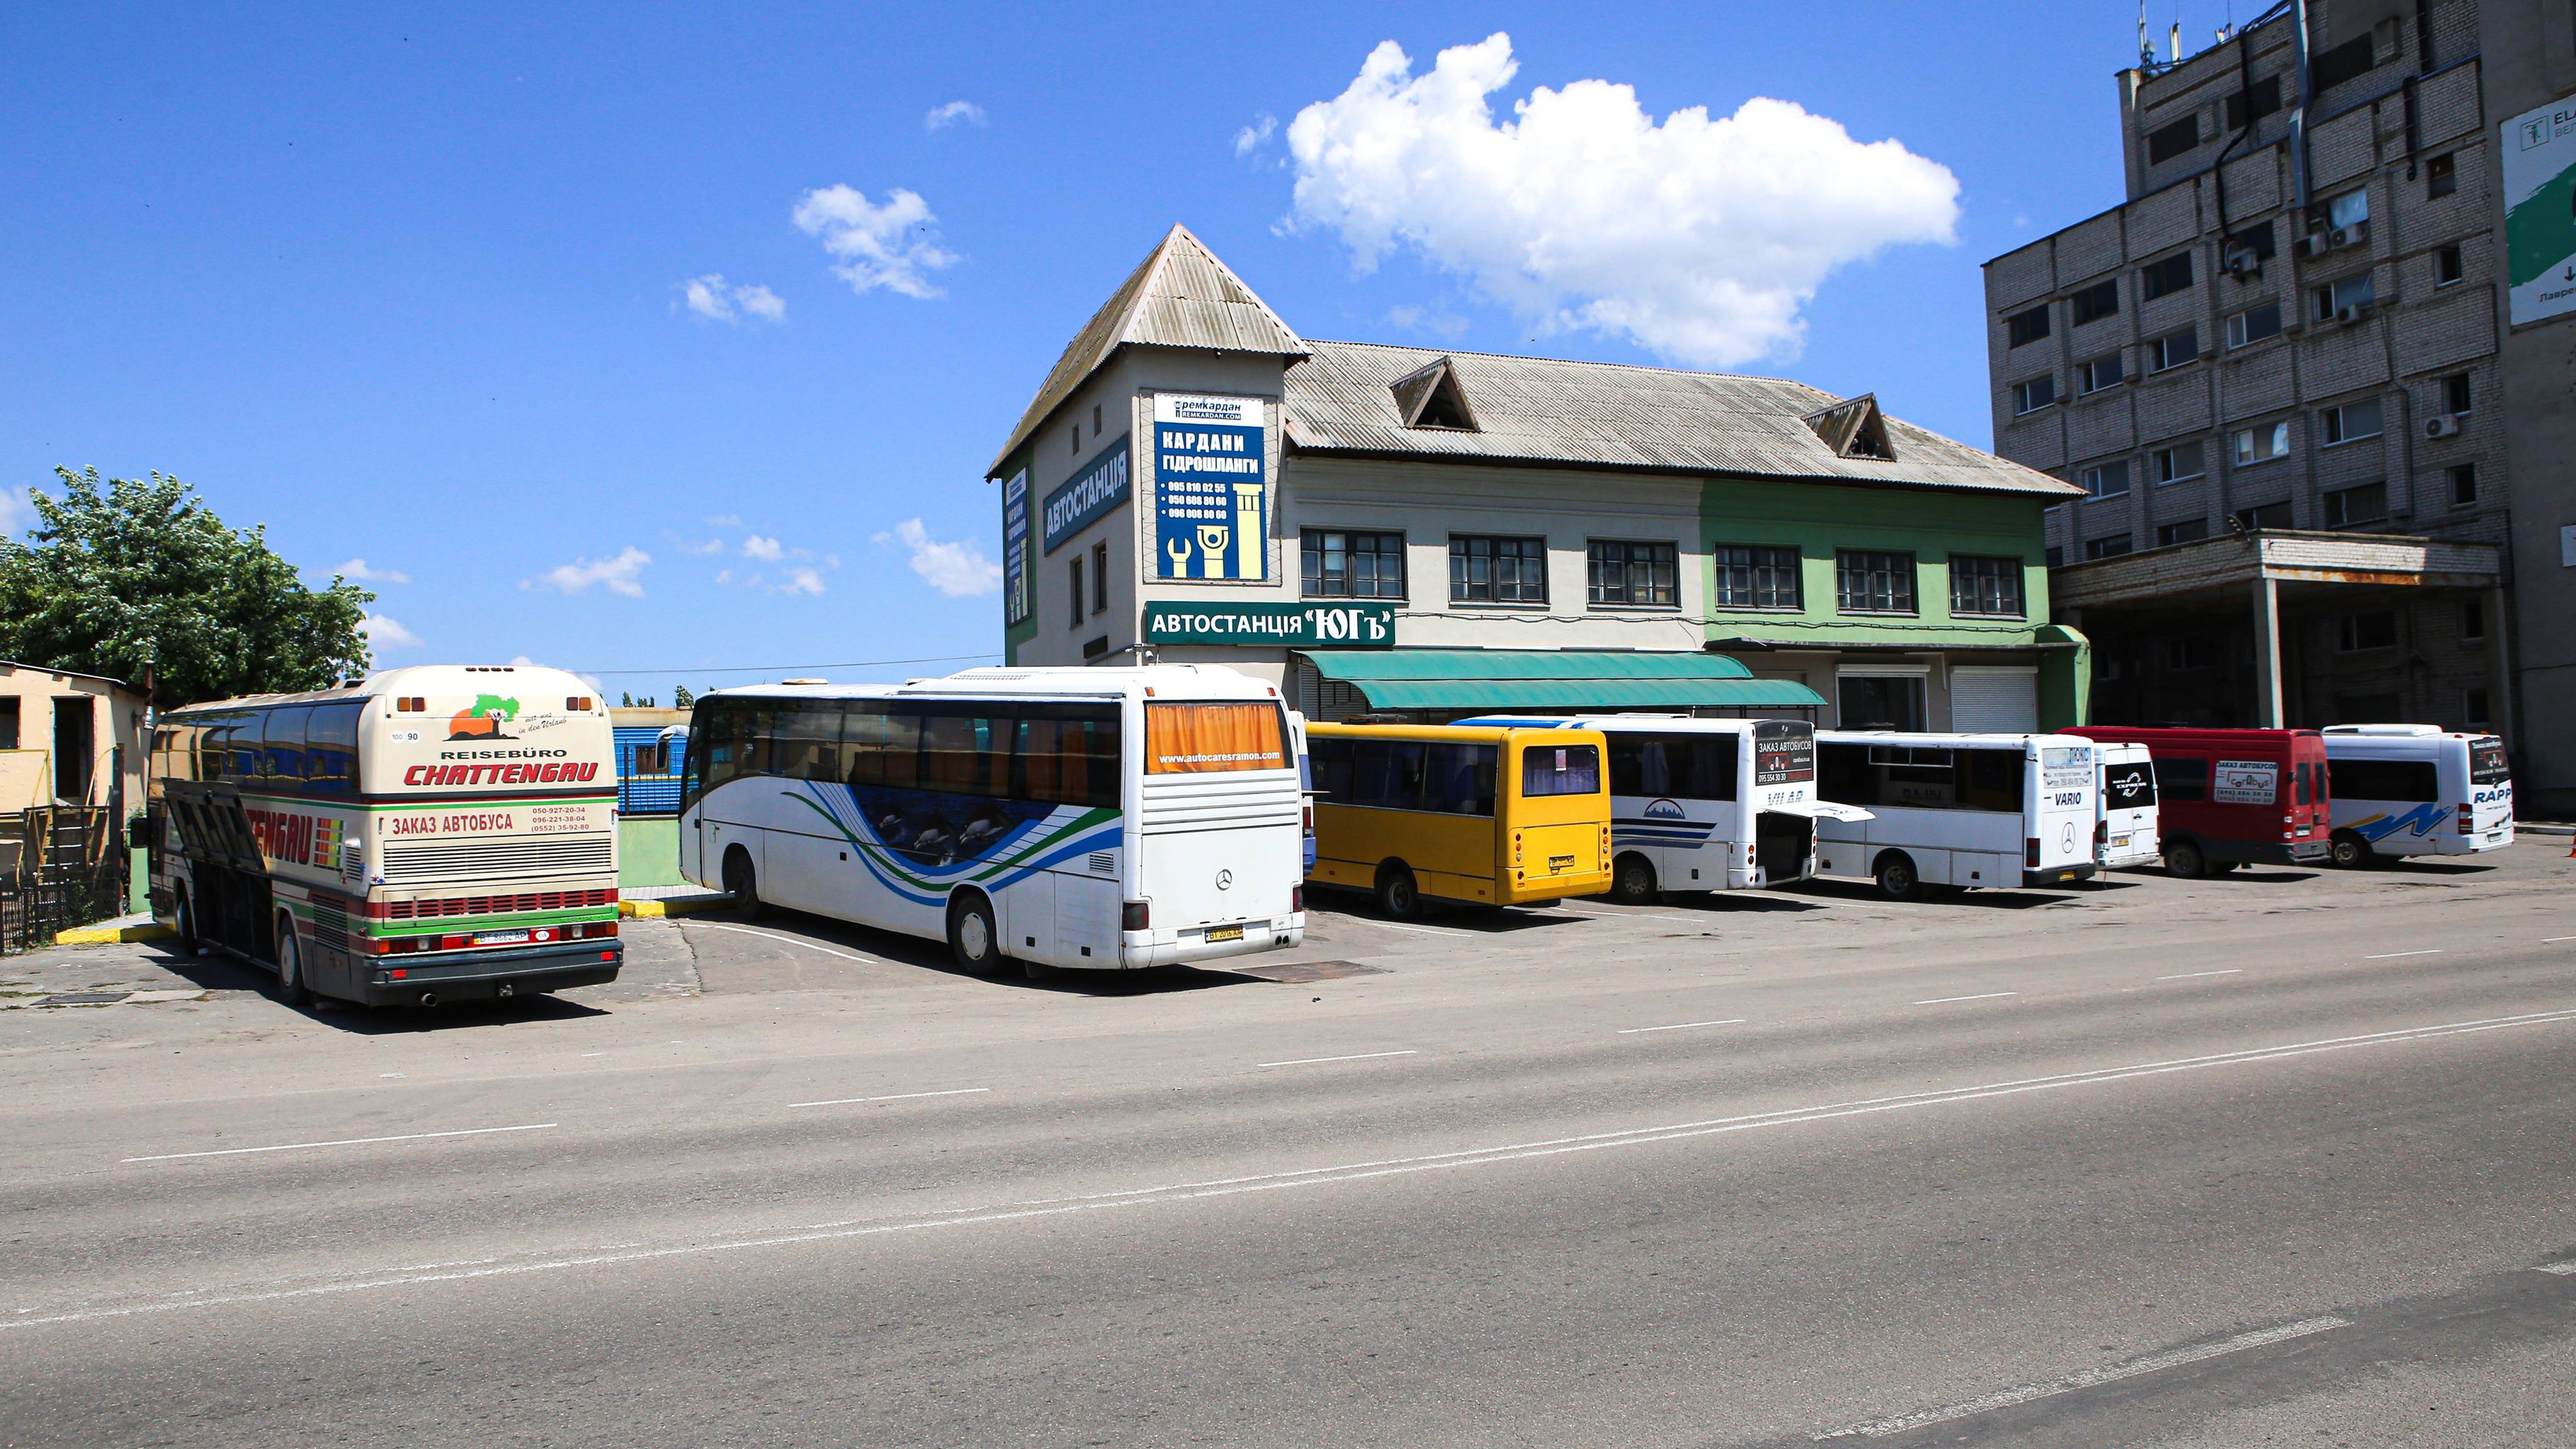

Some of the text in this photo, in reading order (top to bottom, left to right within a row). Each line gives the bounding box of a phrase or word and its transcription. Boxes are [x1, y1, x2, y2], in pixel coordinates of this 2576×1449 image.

[2540, 287, 2576, 302] Лавре
[1182, 402, 1241, 412] ремкардан
[1182, 412, 1241, 420] REMKARDAN.COM
[1162, 432, 1244, 453] КАРДАНИ
[1162, 455, 1259, 473] ГІДРОШЛАНГИ
[1168, 481, 1226, 493] 095 810 02 55
[1046, 450, 1126, 538] АВТОСТАНЦІЯ
[1168, 495, 1227, 507] 050 608 80 60
[1169, 508, 1227, 520] 096 008 80 60
[1152, 613, 1302, 637] АВТОСТАНЦІЯ
[541, 715, 567, 728] Urlaub
[1759, 740, 1812, 753] ЗАКАЗ АВТОБУСОВ
[441, 747, 567, 760] REISEBÜRO
[1159, 751, 1280, 763] www.autocaresramon.com
[403, 762, 599, 786] CHATTENGAU
[1758, 774, 1767, 783] 095
[2055, 792, 2081, 806] VARIO
[393, 813, 513, 835] ЗАКАЗ АВТОБУСА
